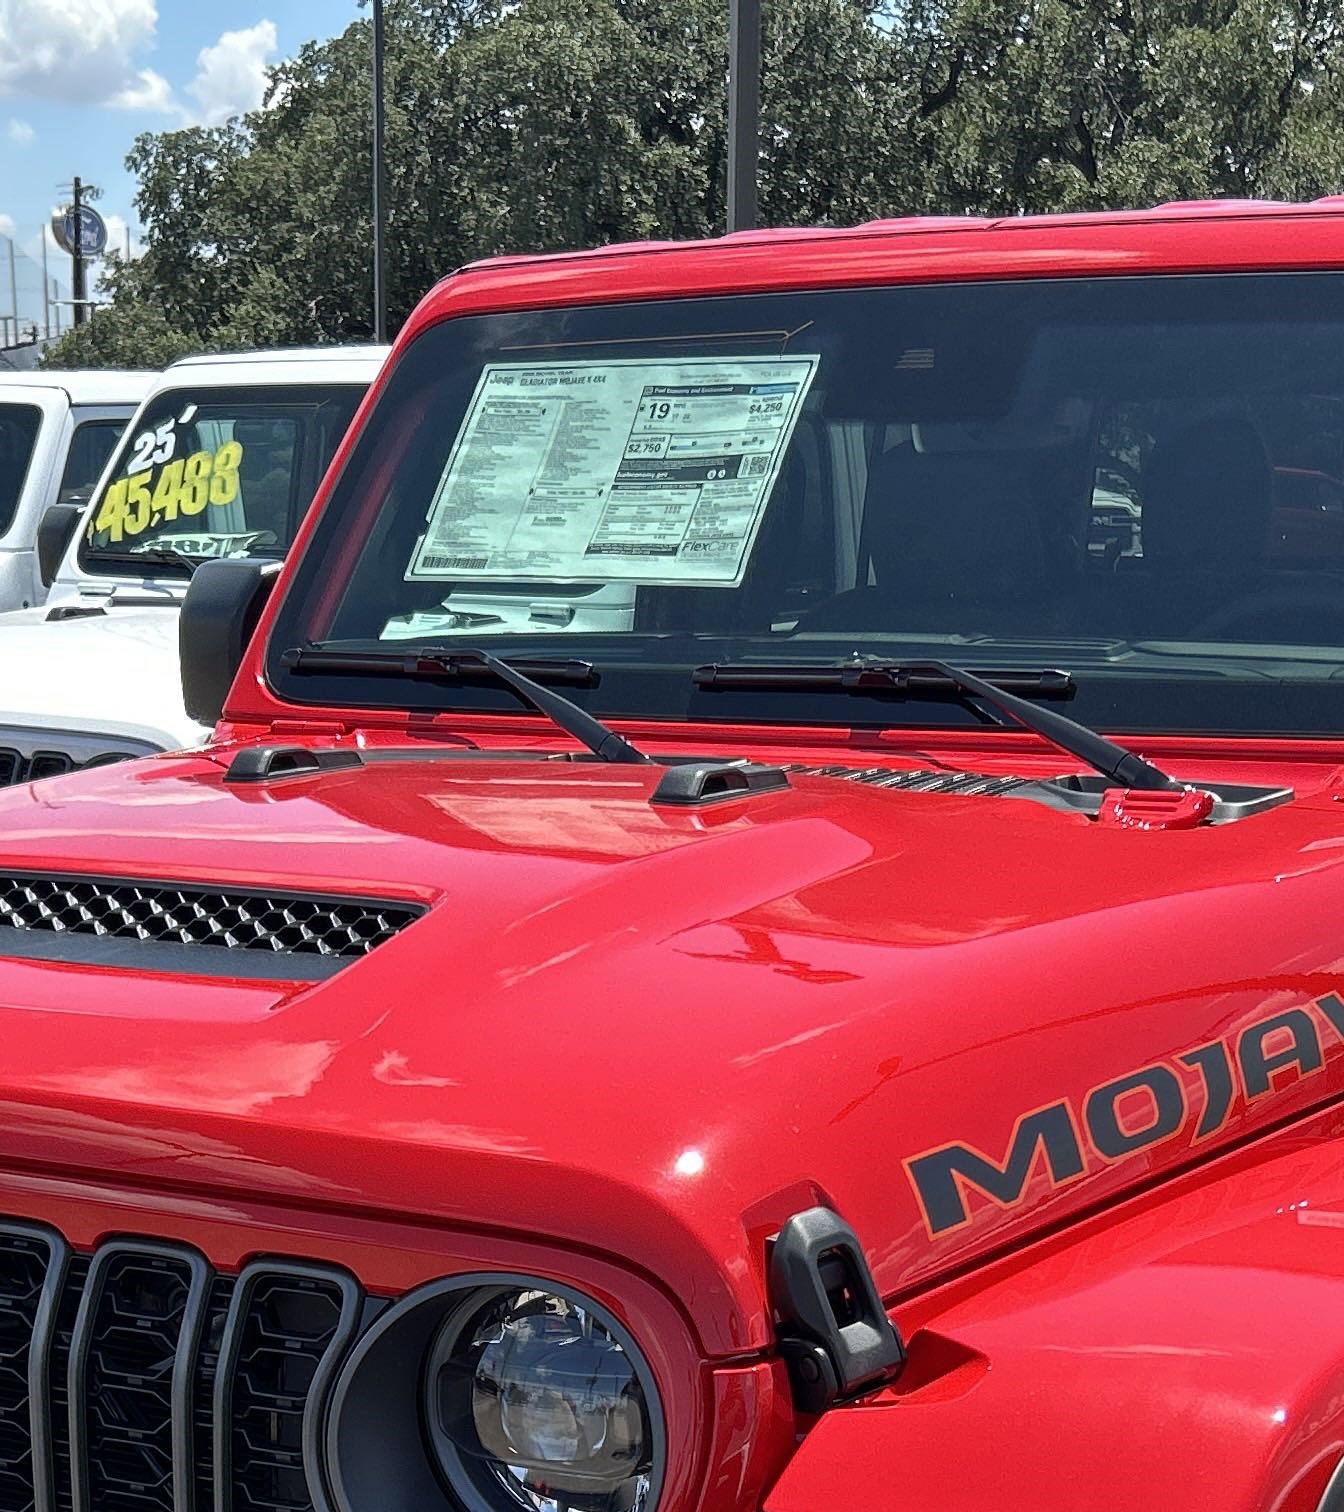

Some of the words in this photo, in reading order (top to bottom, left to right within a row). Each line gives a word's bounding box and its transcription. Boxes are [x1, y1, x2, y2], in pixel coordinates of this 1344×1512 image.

[490, 374, 514, 385] Jeep
[650, 402, 671, 419] 19
[749, 401, 783, 415] $4,250
[628, 443, 662, 454] $2,750
[682, 541, 739, 552] FlexCare
